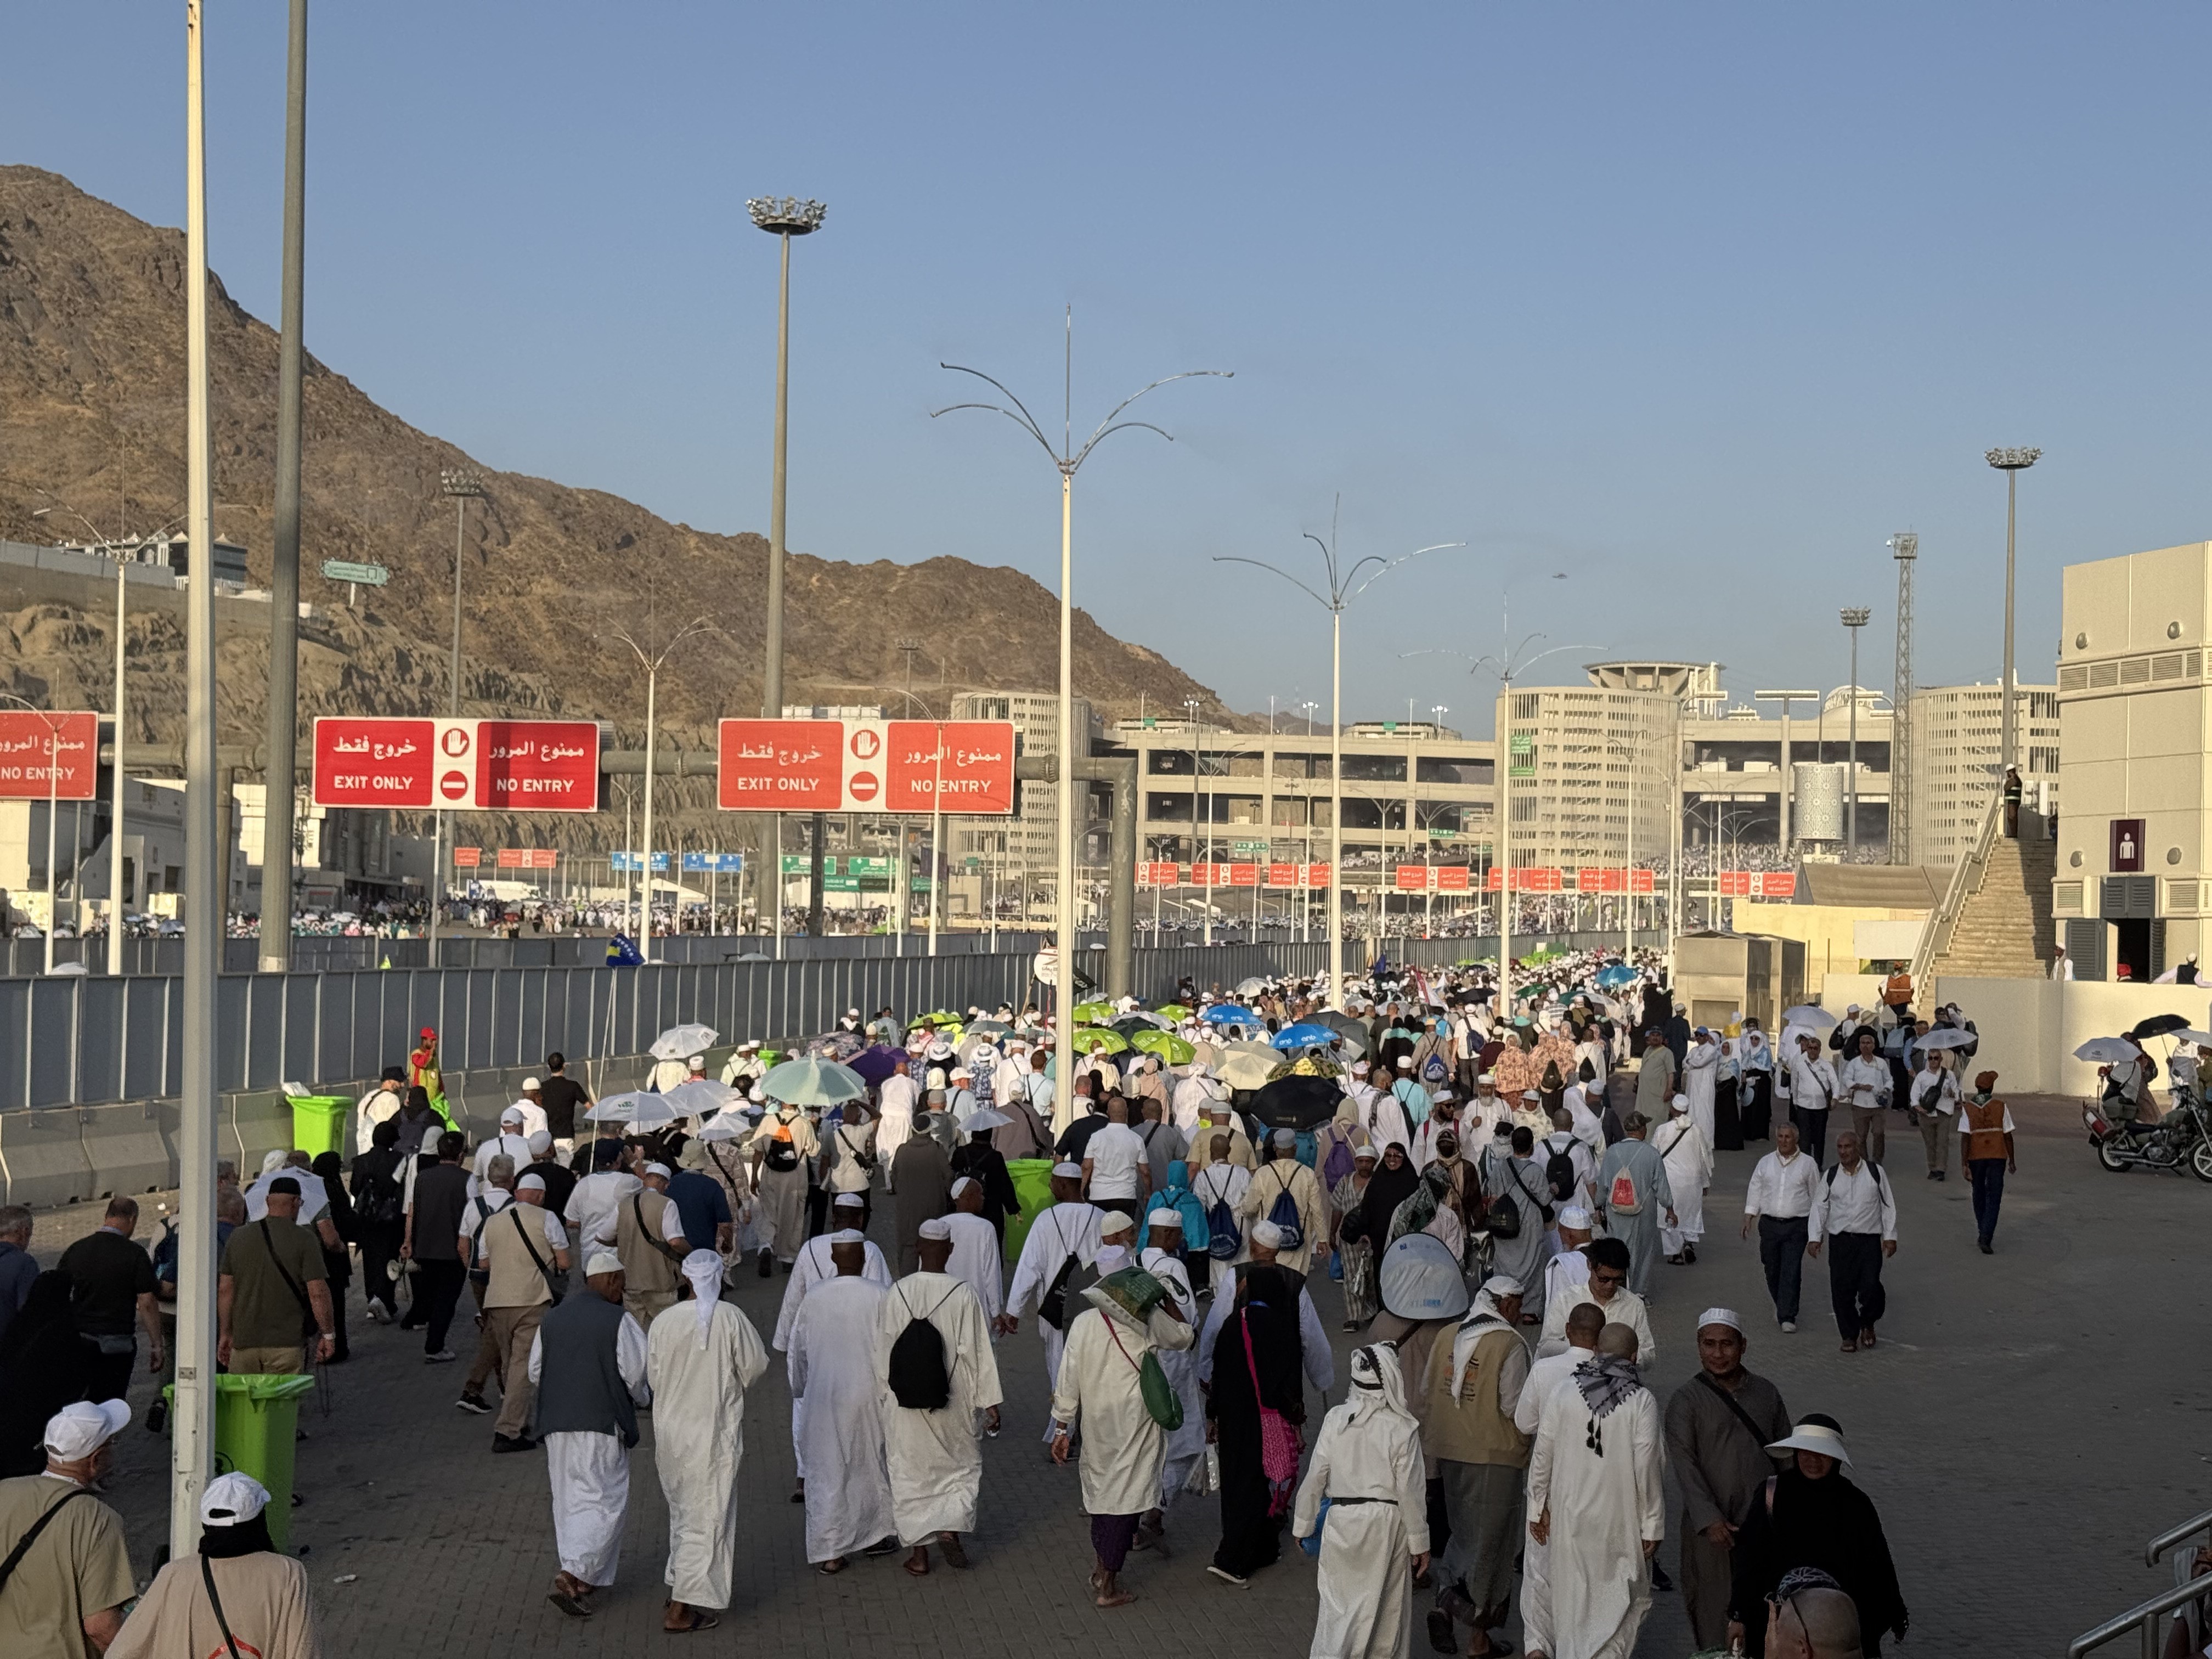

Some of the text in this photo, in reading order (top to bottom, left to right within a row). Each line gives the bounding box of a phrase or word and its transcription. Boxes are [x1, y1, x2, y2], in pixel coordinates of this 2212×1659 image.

[333, 735, 417, 760] خروج فقط
[489, 741, 584, 762] ممنوع المرور
[737, 741, 823, 766] خروج فقط
[904, 745, 1001, 767] ممنوع المرور
[1, 767, 75, 780] NO ENTRY
[334, 775, 413, 789] EXIT ONLY
[496, 778, 574, 793] NO ENTRY
[738, 777, 820, 791] EXIT ONLY
[911, 779, 992, 793] NO ENTRY
